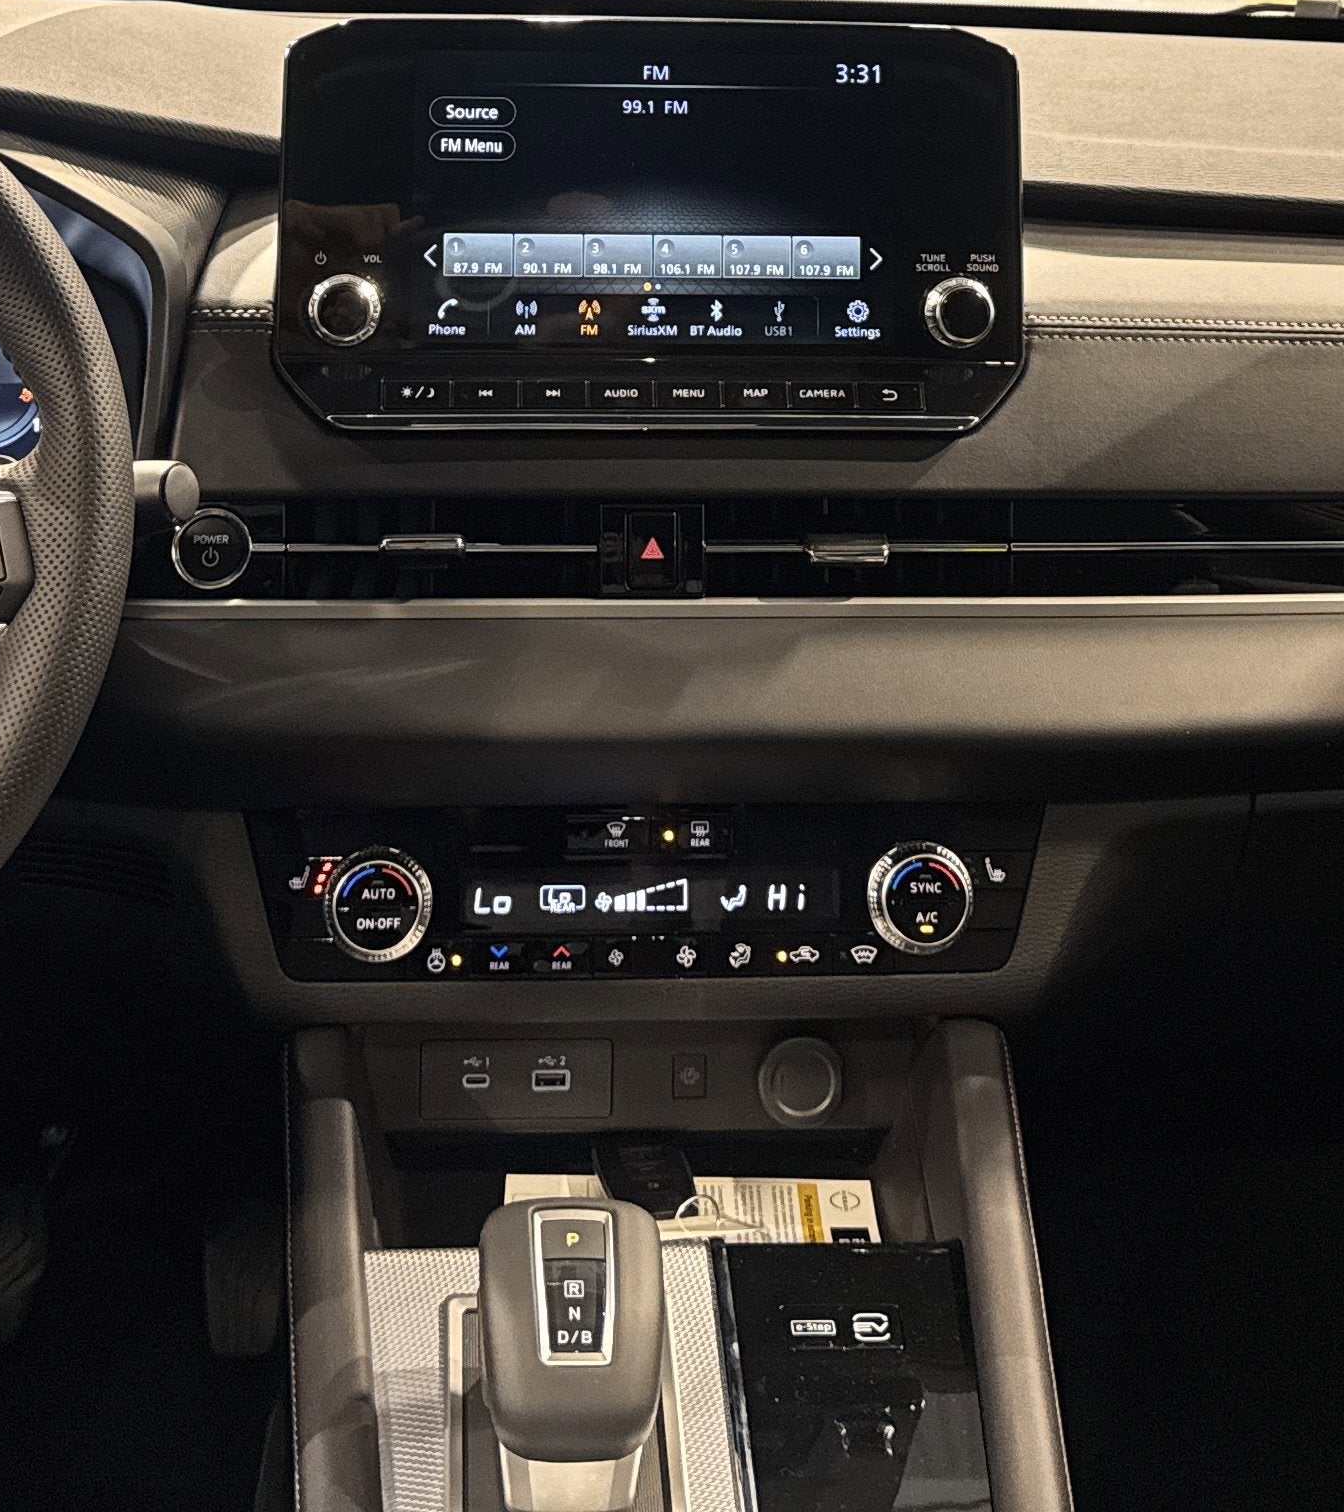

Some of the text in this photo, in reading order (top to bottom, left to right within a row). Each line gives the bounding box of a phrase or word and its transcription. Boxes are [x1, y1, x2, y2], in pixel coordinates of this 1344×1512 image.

[643, 65, 669, 80] FM
[835, 64, 881, 84] 3:31
[445, 104, 499, 119] Source
[622, 99, 688, 115] 99.1 FM
[440, 138, 503, 153] FM Menu
[522, 242, 530, 253] 2
[592, 243, 600, 254] 3
[661, 243, 670, 254] 4
[730, 243, 739, 254] 5
[800, 244, 808, 255] 6
[363, 253, 382, 264] VOL
[920, 254, 946, 263] TUNE
[970, 254, 995, 263] PUSH
[453, 262, 503, 274] 87.9 FM
[523, 263, 572, 274] 90.1 FM
[593, 263, 642, 275] 98.1 FM
[660, 264, 714, 275] 106.1 FM
[729, 264, 784, 276] 107.9 FM
[799, 265, 854, 277] 107.9 FM
[915, 263, 951, 272] SCROLL
[966, 263, 1000, 273] SOUND
[428, 324, 466, 336] Phone
[515, 324, 536, 336] AM
[581, 324, 598, 336] FM
[627, 325, 678, 337] SiriusXM
[690, 326, 743, 337] BT Audio
[834, 326, 880, 339] Settings
[604, 388, 639, 399] AUDIO
[672, 389, 705, 399] MENU
[743, 388, 768, 398] MAP
[799, 389, 846, 399] CAMERA
[193, 535, 229, 545] POWER
[604, 838, 629, 848] FRONT
[690, 838, 710, 847] REAR
[362, 888, 395, 900] AUTO
[910, 882, 942, 894] SYNC
[474, 887, 512, 915] Lo
[768, 884, 805, 911] Hi
[915, 911, 938, 923] A/C
[490, 961, 509, 970] REAR
[552, 961, 572, 970] REAR
[566, 1232, 580, 1247] P
[568, 1282, 580, 1296] R
[568, 1306, 581, 1321] N
[558, 1330, 592, 1344] D/B
